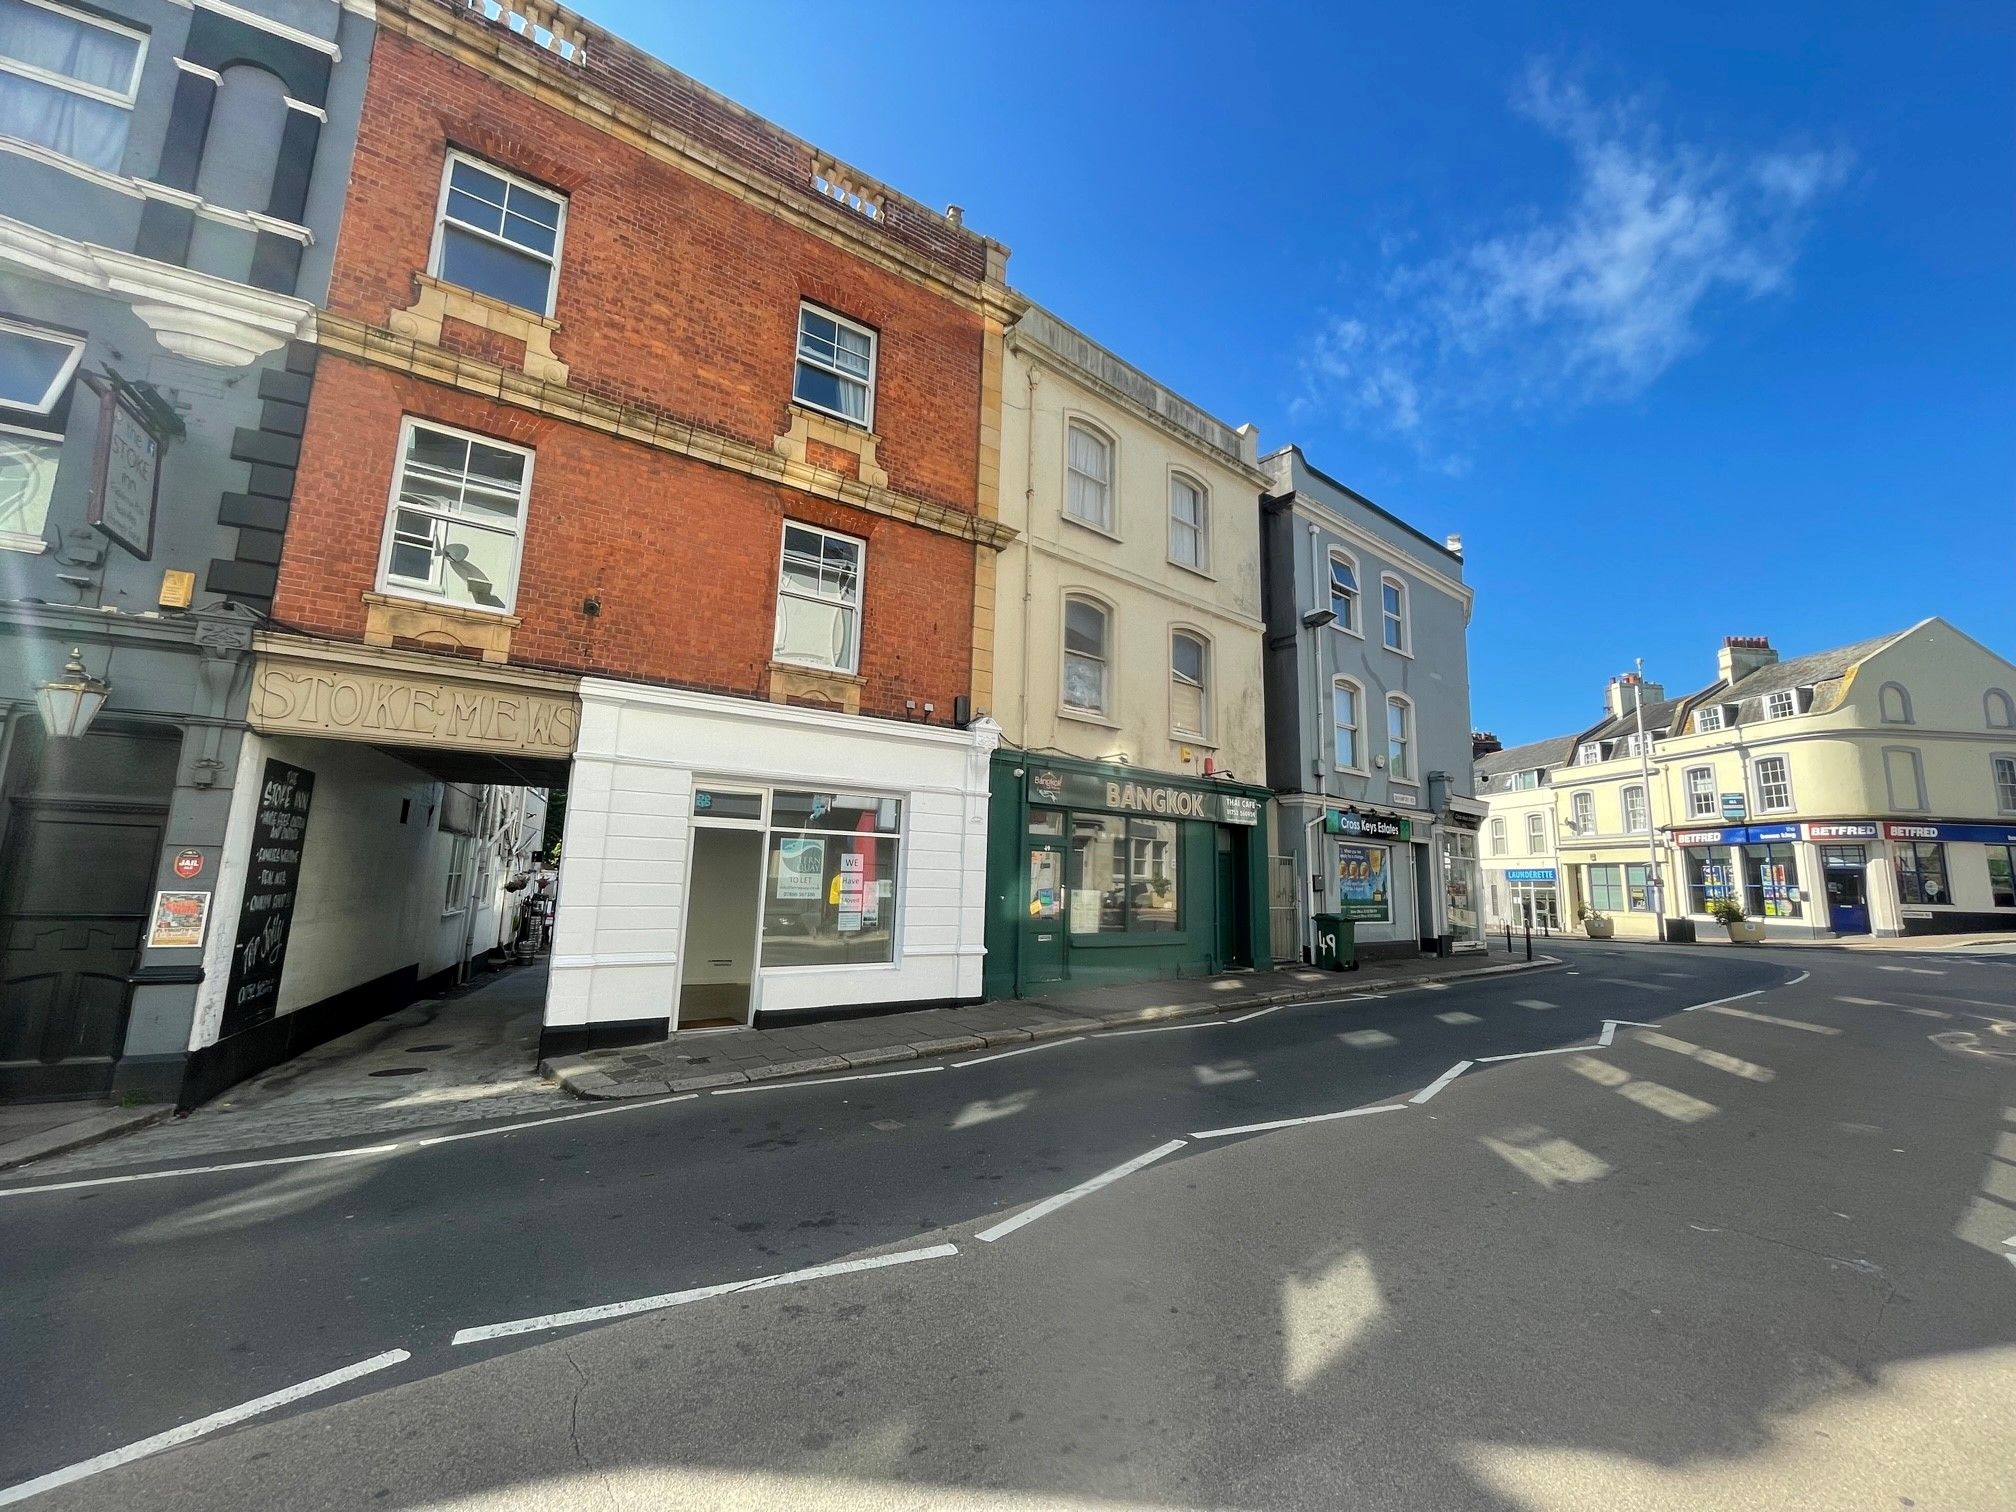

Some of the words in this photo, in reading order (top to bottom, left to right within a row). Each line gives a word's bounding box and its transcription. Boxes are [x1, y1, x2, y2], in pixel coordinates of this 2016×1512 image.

[112, 433, 151, 482] STOKE
[263, 781, 294, 808] STOKE
[1106, 782, 1205, 817] BANGKOK
[1226, 798, 1240, 807] THAI
[1241, 800, 1256, 809] CAFE
[1341, 817, 1360, 830] Cross
[1361, 820, 1377, 834] Keys
[1377, 822, 1399, 835] Estates
[1811, 825, 1876, 836] BETFRED
[1890, 825, 1938, 838] BETFRED
[1679, 832, 1721, 843] BETFRED
[178, 859, 200, 867] JAIL
[845, 858, 859, 867] WE
[789, 876, 799, 884] TO
[800, 876, 812, 884] LET
[1508, 870, 1554, 879] LAUNDERETTE
[1318, 930, 1336, 958] 49
